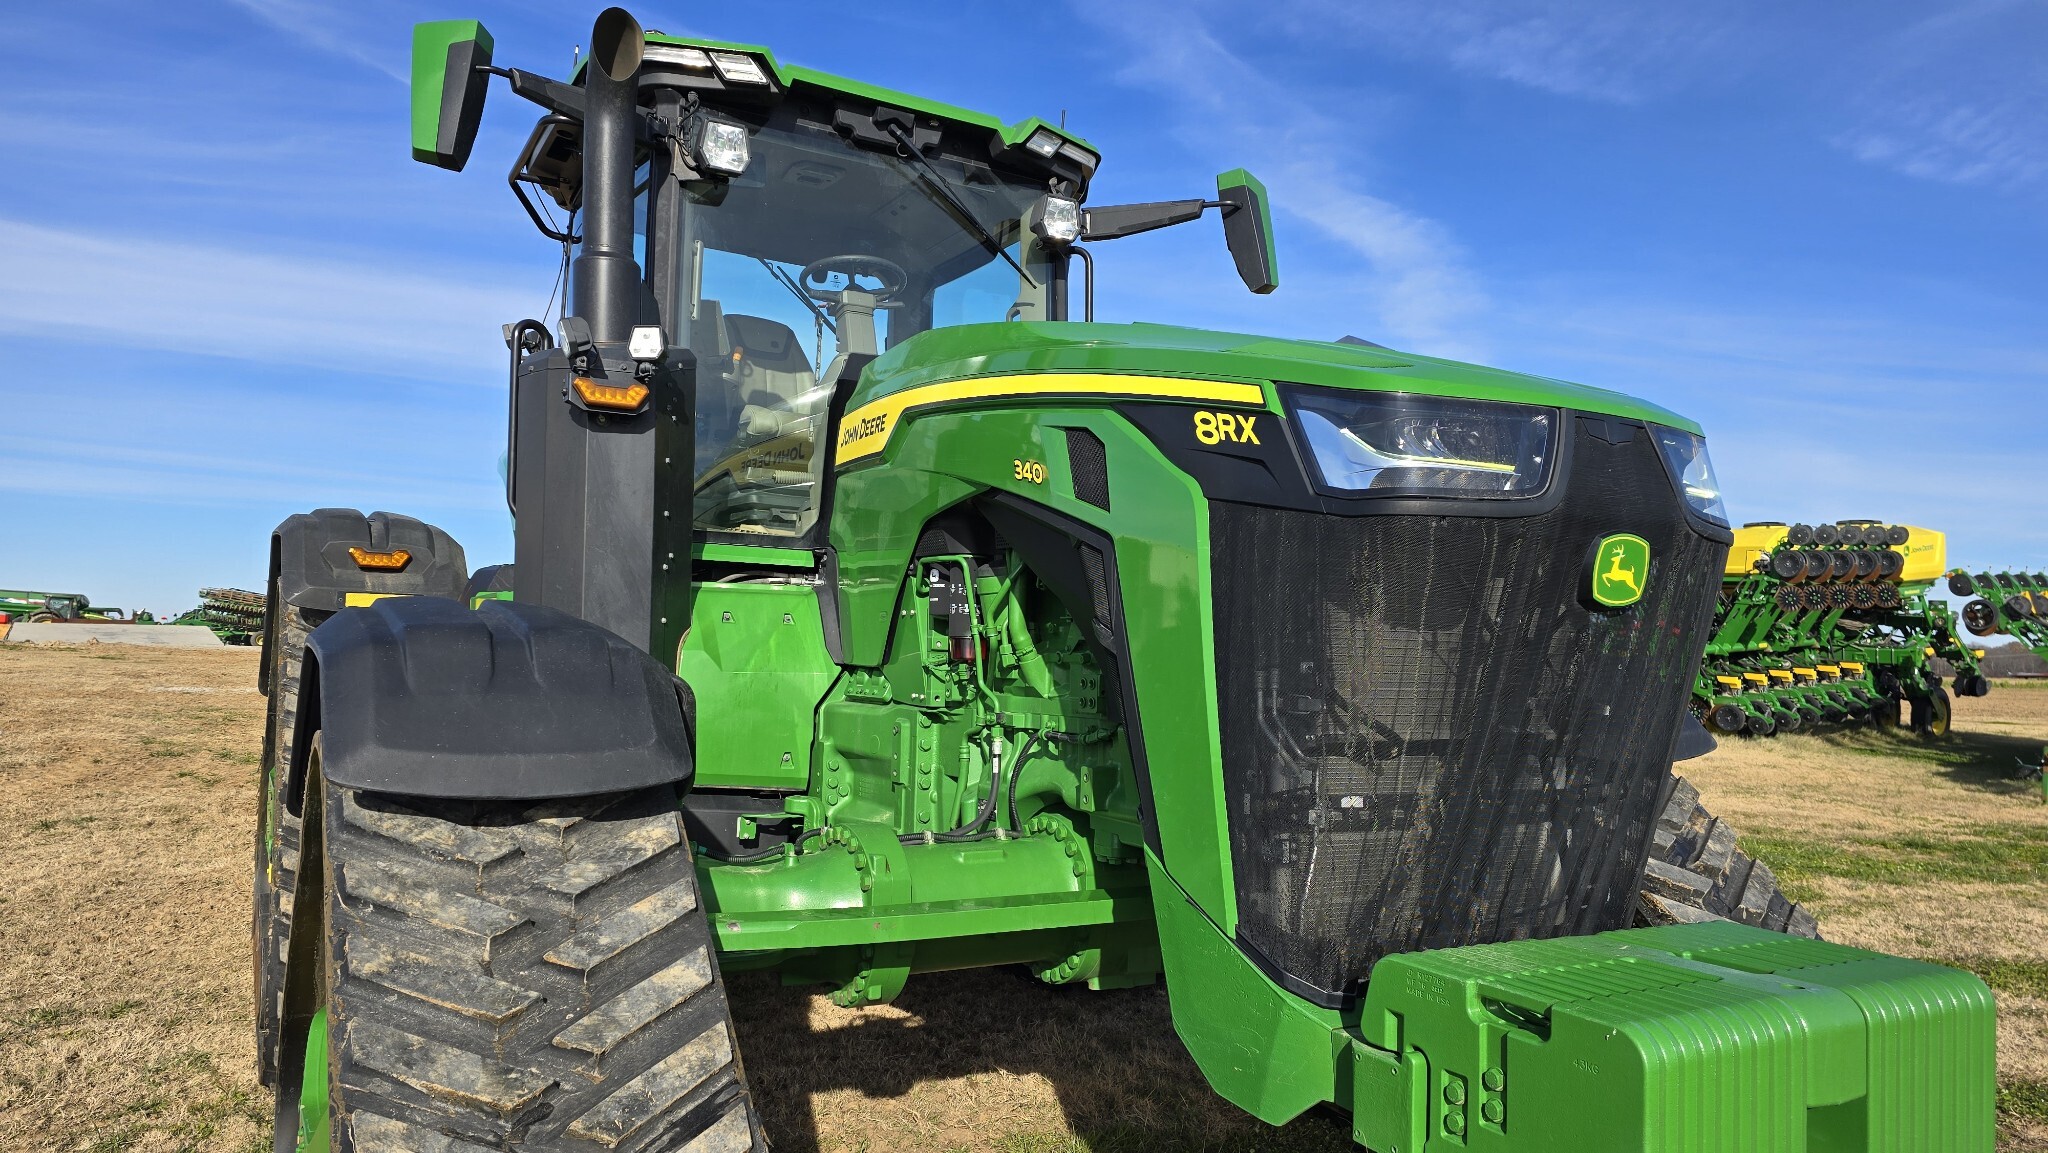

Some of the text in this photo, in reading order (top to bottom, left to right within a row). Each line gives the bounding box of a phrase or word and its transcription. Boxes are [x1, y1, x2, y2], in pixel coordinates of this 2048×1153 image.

[841, 413, 888, 448] JOHN DEERE
[1193, 410, 1261, 445] 8RX
[1013, 458, 1044, 485] 340
[1406, 986, 1451, 1007] MADE IN USA
[1573, 1059, 1600, 1075] 43KG
